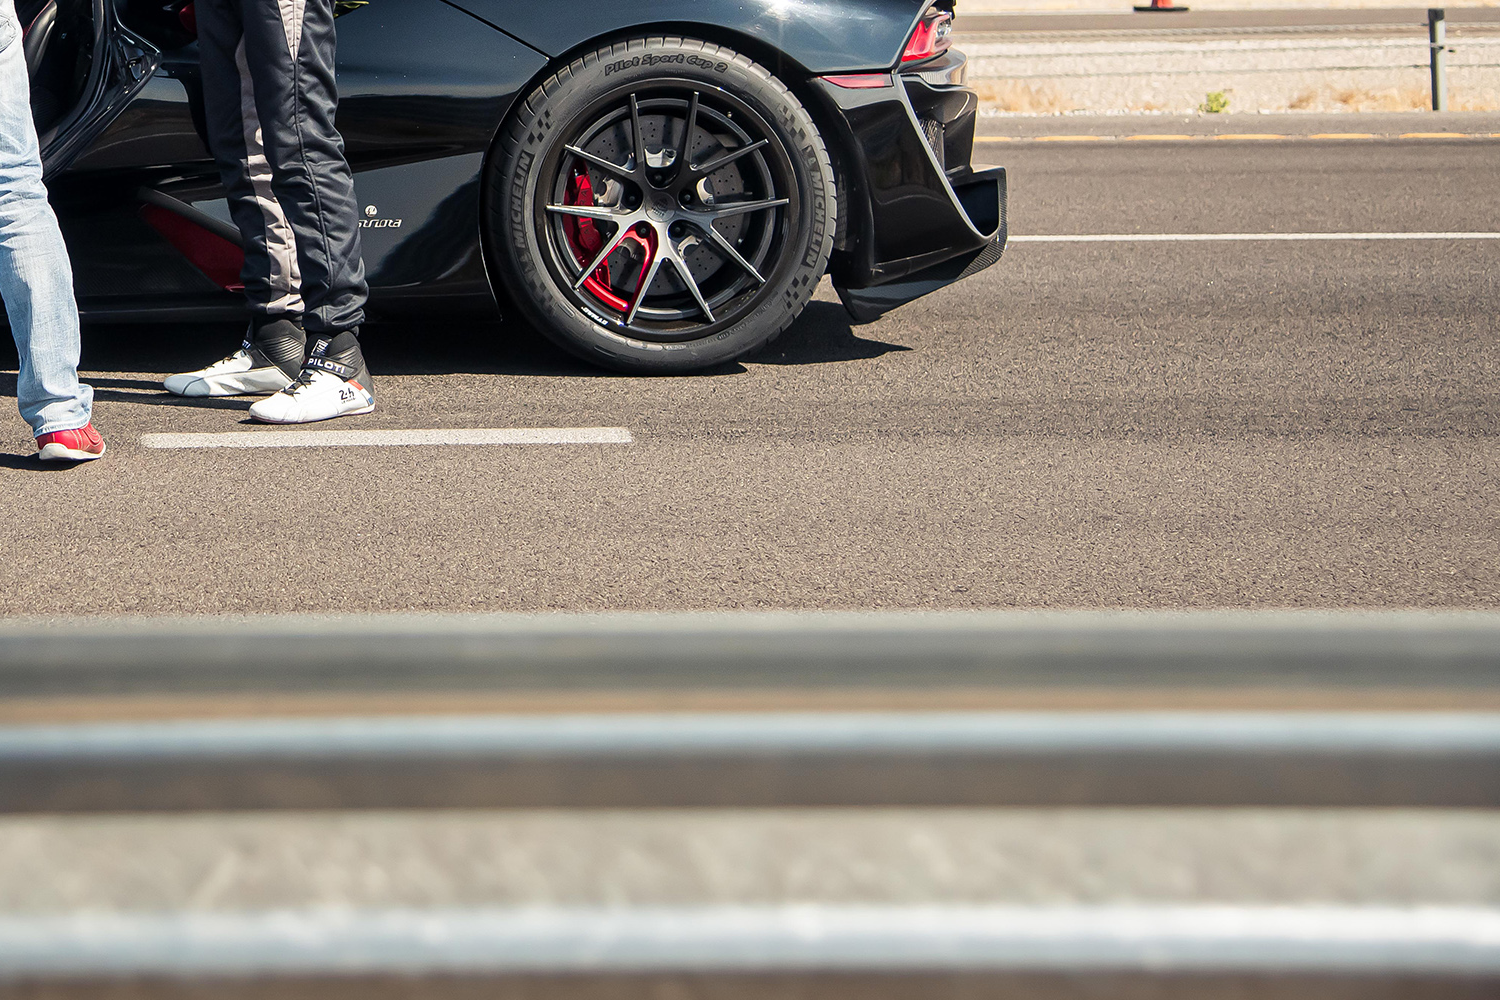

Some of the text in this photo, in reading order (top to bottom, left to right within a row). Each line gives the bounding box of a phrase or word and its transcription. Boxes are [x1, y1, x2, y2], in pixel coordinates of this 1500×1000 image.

[640, 53, 685, 67] Sport
[686, 54, 713, 70] Cup
[713, 60, 729, 73] 2
[510, 152, 531, 249] MICHELIN
[804, 172, 826, 269] MICHELIN
[307, 357, 345, 374] PILOTI
